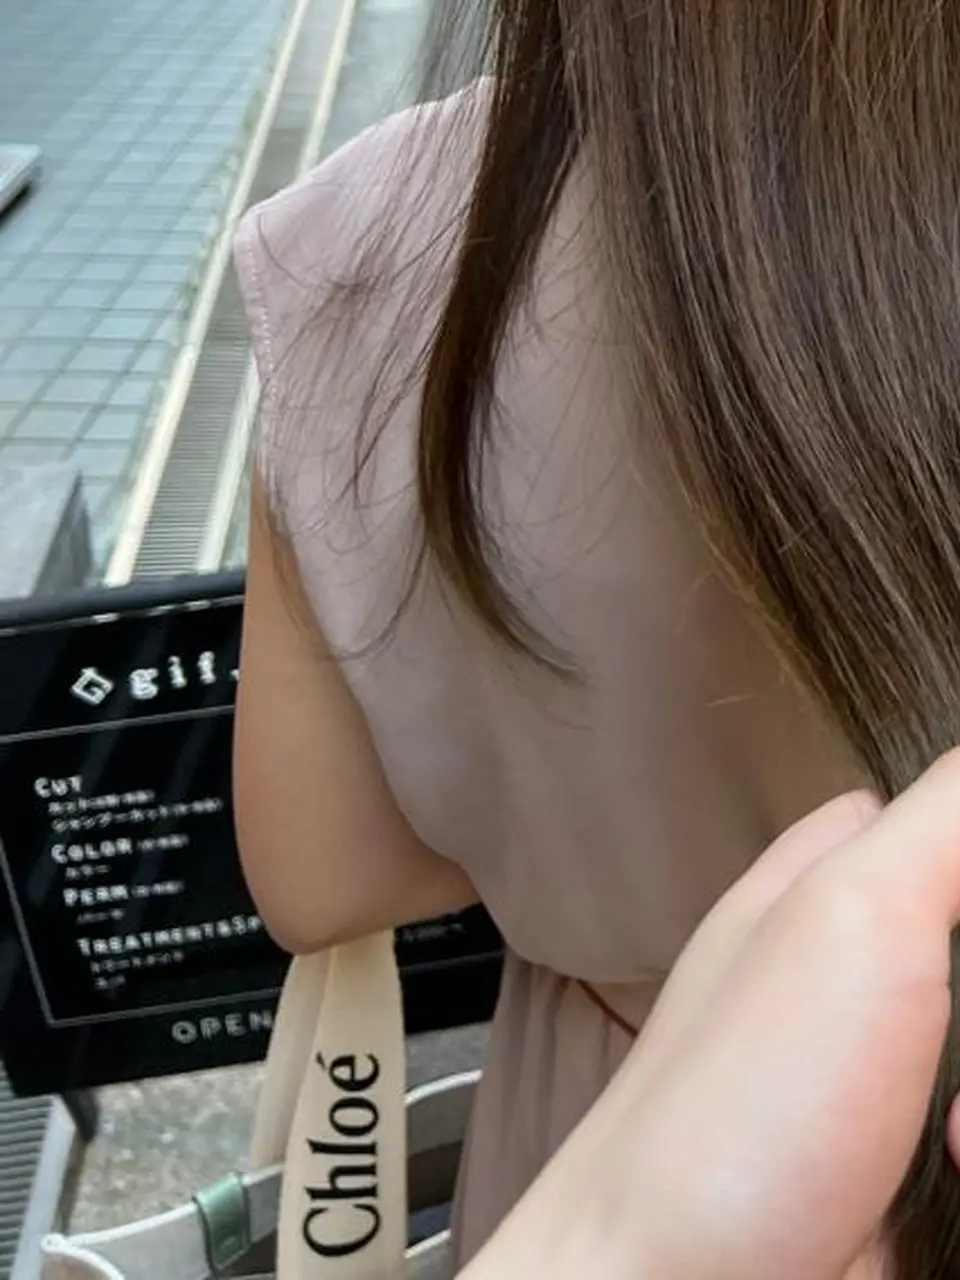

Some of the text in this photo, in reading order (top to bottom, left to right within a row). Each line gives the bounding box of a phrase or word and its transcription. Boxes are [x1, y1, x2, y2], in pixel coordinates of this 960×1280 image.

[128, 650, 241, 700] gif
[171, 1009, 272, 1044] OPEN
[303, 1051, 381, 1257] Chloé
